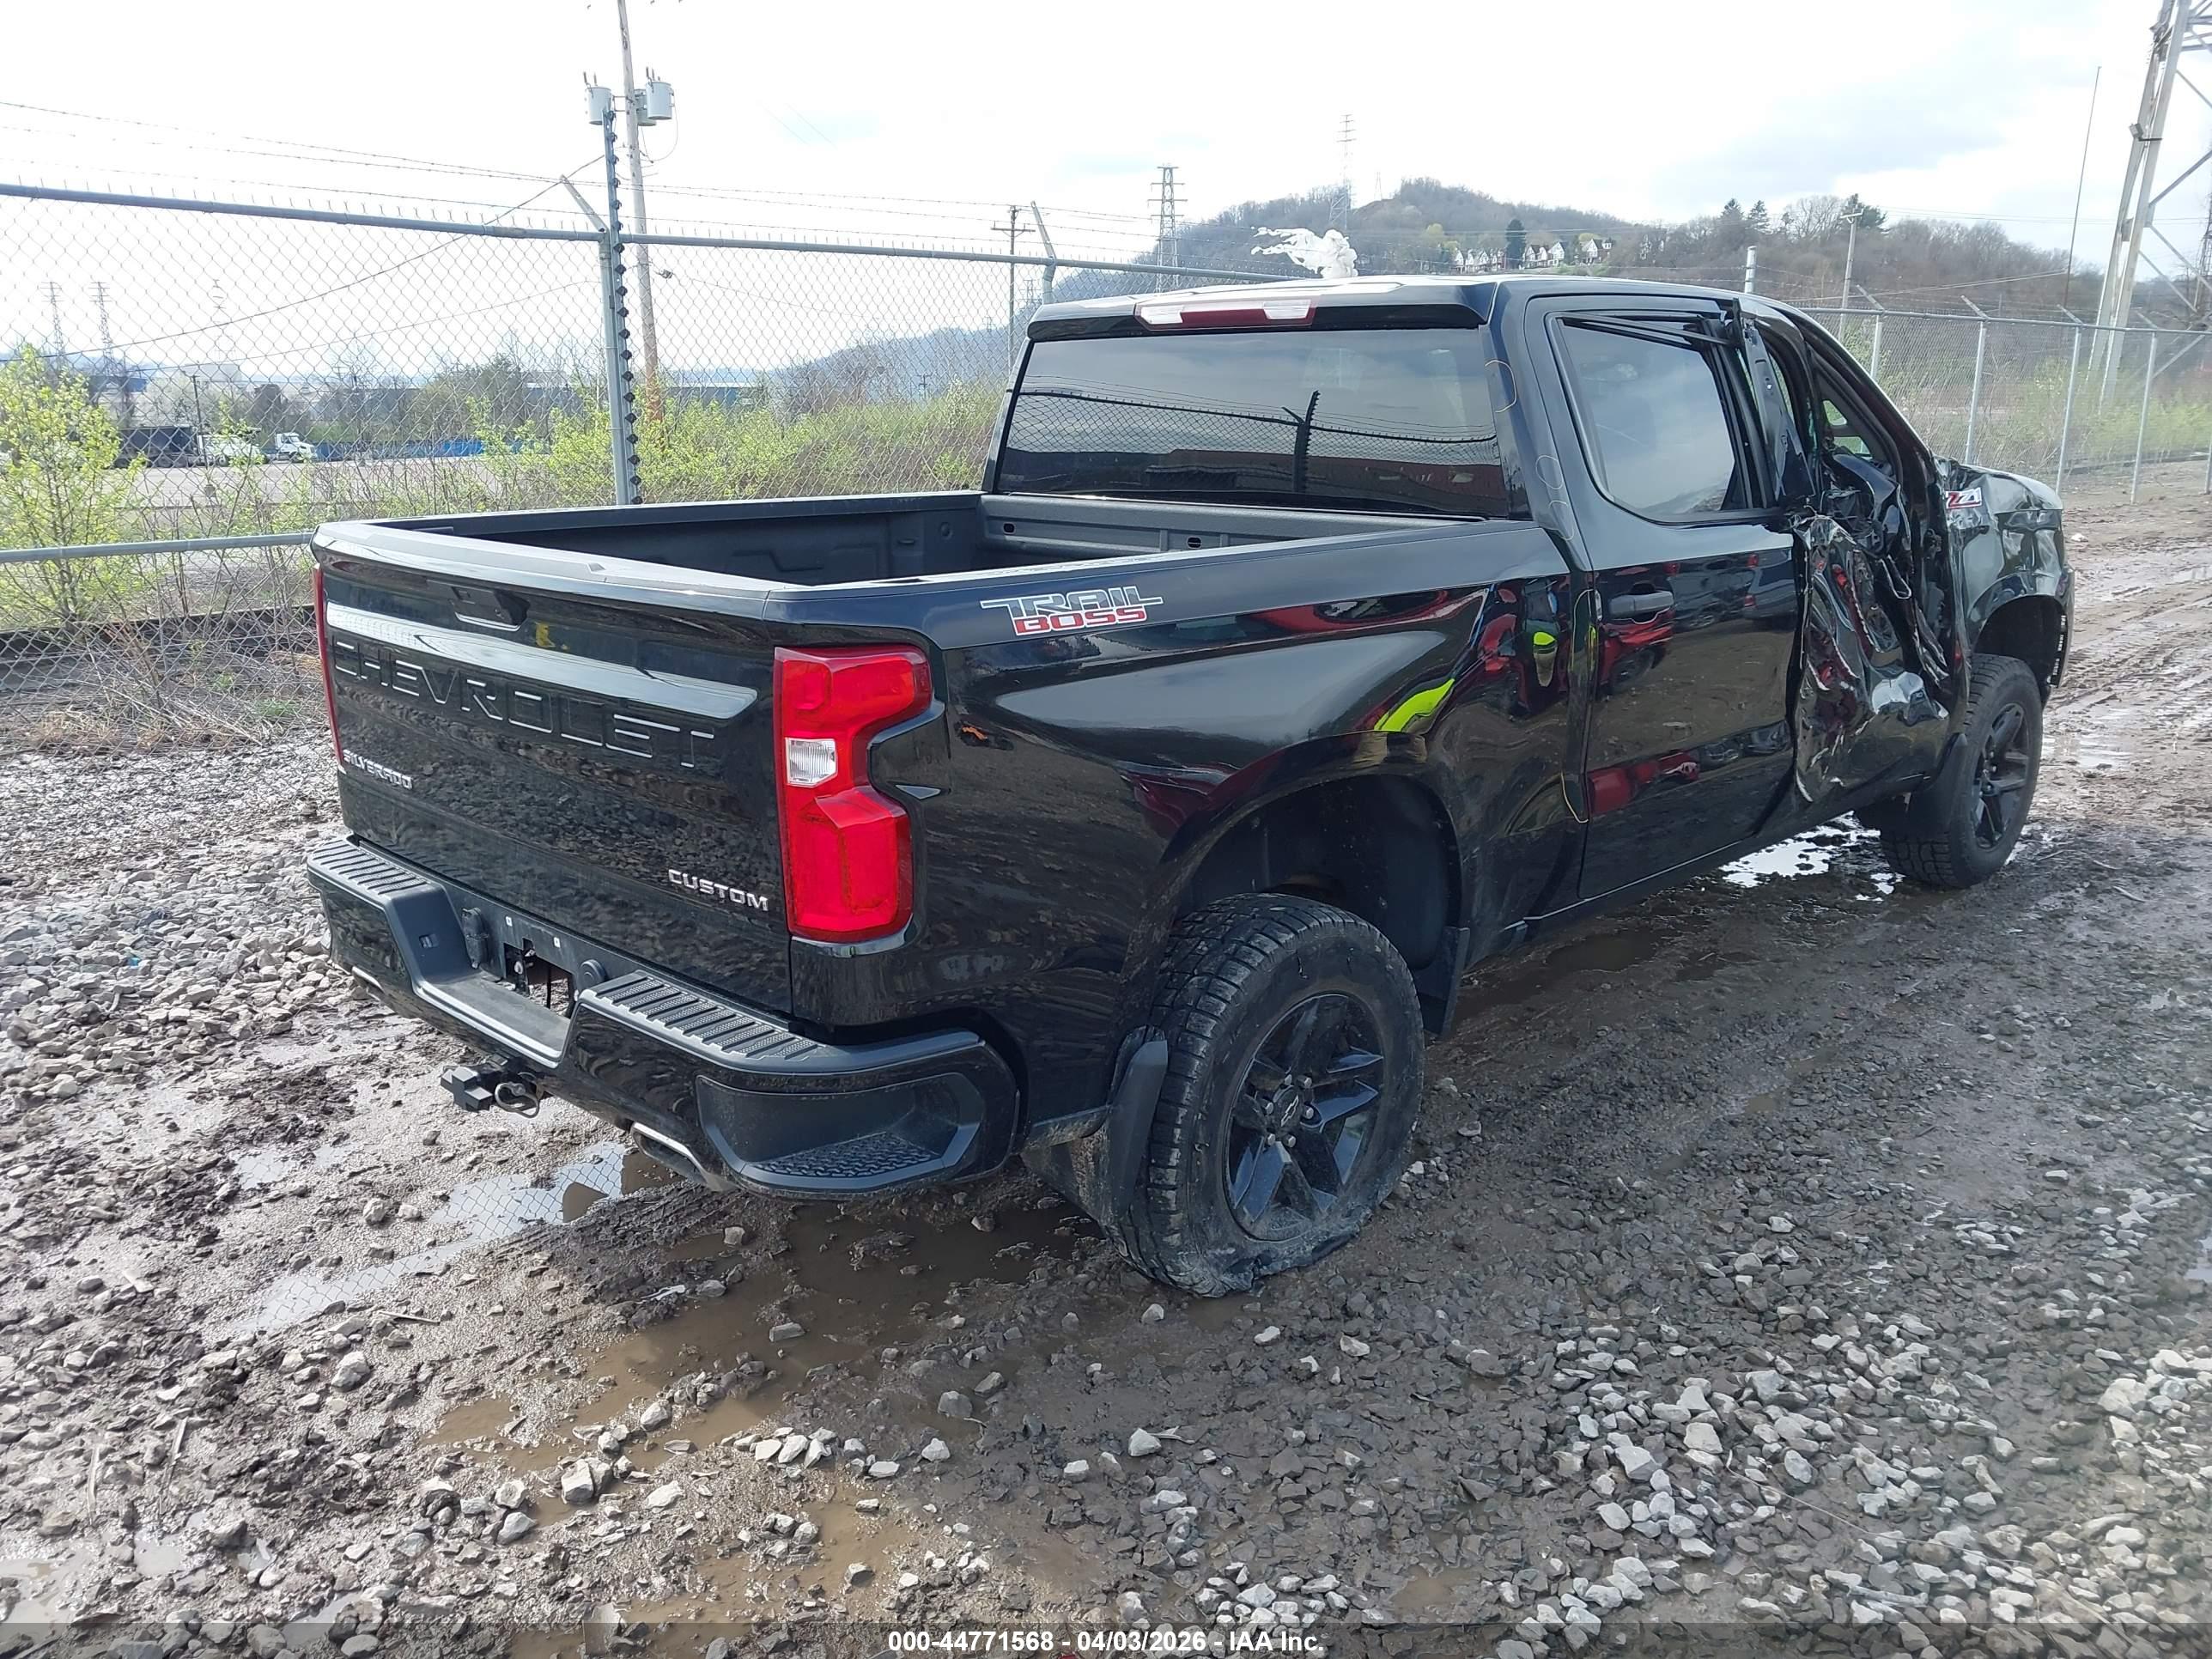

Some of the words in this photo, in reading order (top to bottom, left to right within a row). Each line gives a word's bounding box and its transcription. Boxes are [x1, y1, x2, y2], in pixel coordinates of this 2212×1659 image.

[1945, 487, 1982, 509] Z71
[980, 586, 1164, 618] TRAIL
[1012, 605, 1147, 636] BOSS
[331, 635, 715, 768] CHEVROLET
[342, 748, 414, 789] SILVERADO
[668, 869, 769, 911] CUSTOM
